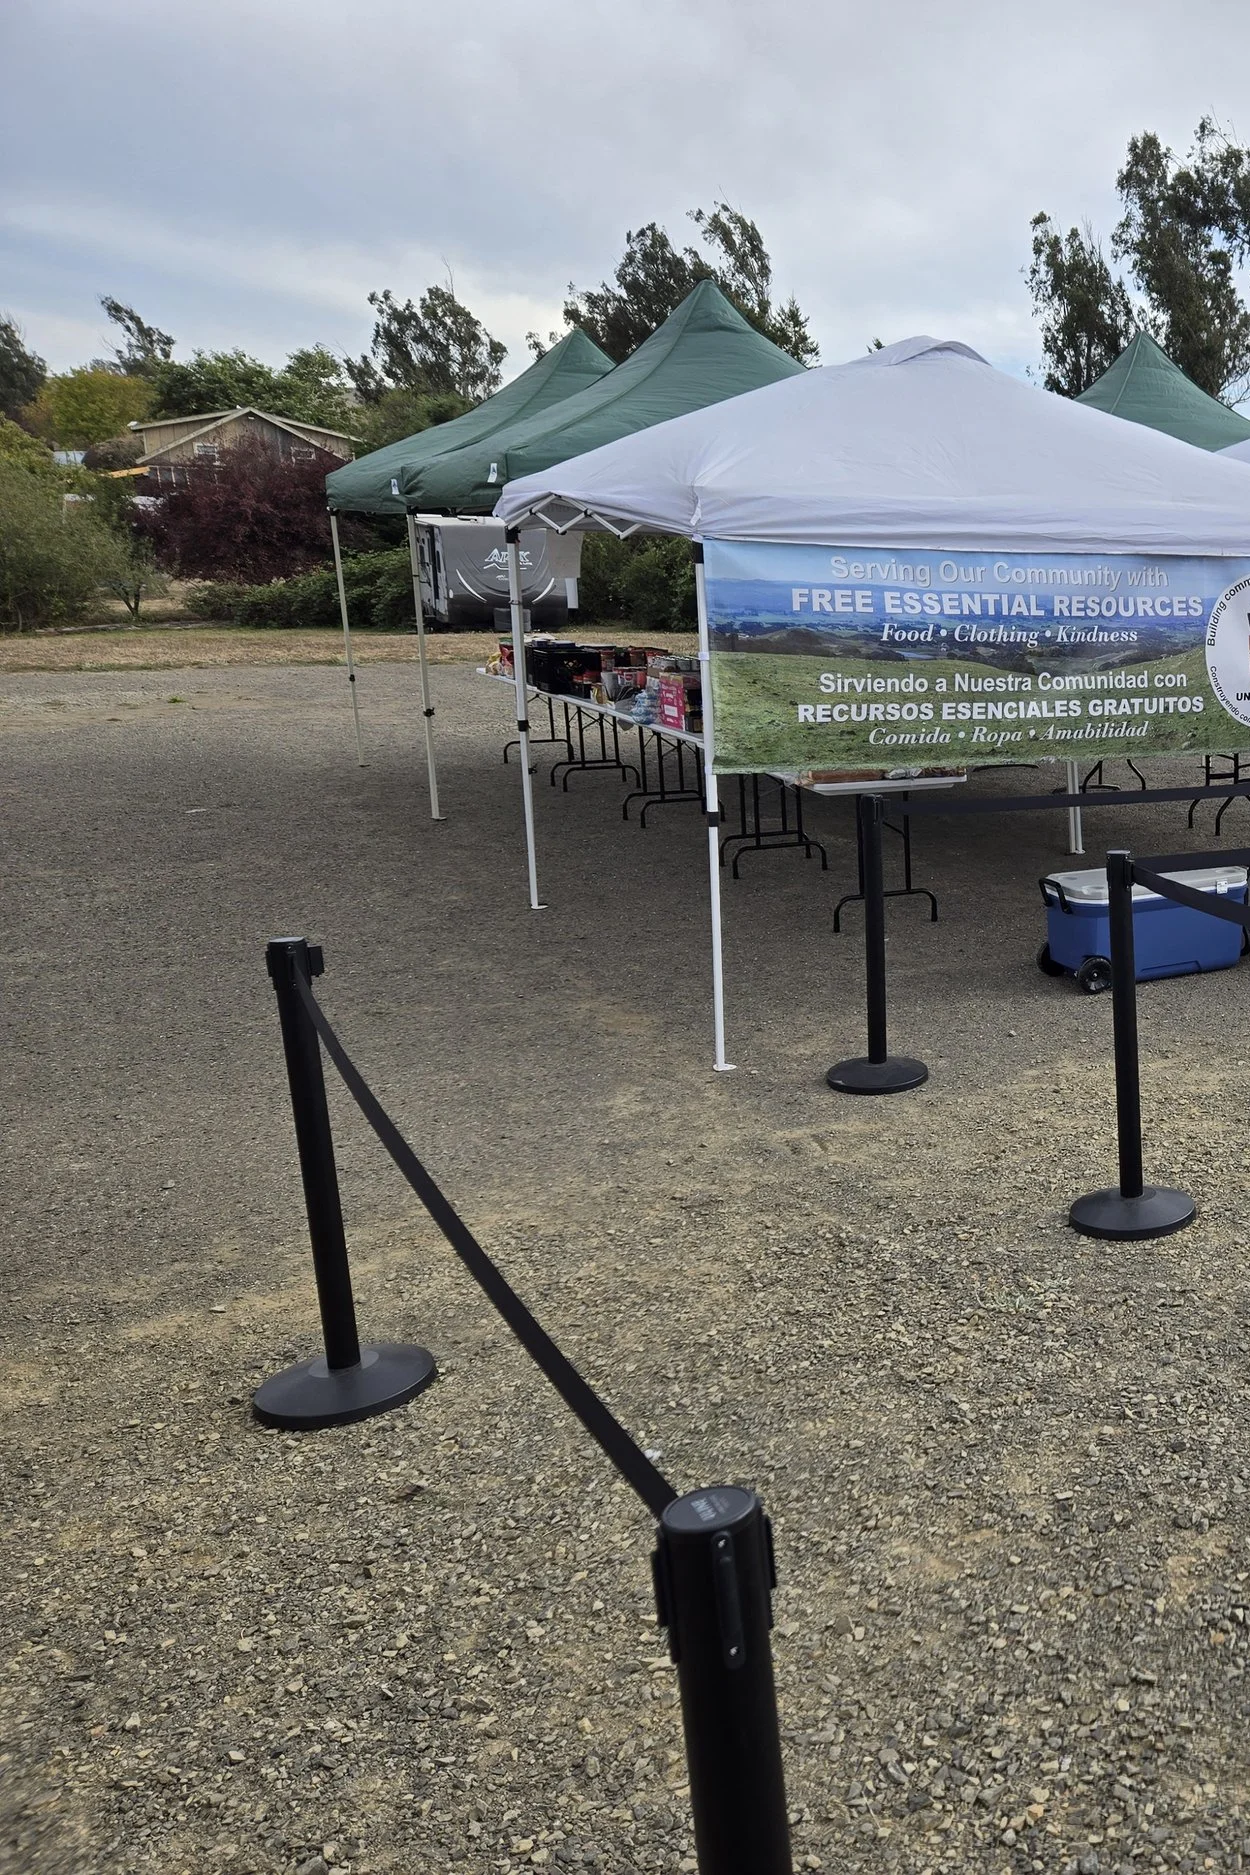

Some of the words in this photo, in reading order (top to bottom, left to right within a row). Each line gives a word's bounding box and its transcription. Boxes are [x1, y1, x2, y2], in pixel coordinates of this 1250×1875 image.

[830, 555, 932, 588] Serving
[939, 560, 986, 583] Our
[993, 561, 1122, 592] Community
[1127, 566, 1170, 587] with
[791, 588, 874, 613] FREE
[884, 591, 1045, 617] ESSENTIAL
[1053, 595, 1204, 618] RESOURCES
[880, 622, 935, 642] Food
[954, 624, 1040, 648] Clothing
[1056, 625, 1138, 643] Kindness
[1207, 601, 1227, 646] Building
[819, 673, 929, 693] Sirviendo
[935, 677, 947, 693] a
[954, 673, 1032, 693] Nuestra
[1038, 670, 1149, 690] Comunidad
[1154, 673, 1187, 688] con
[1210, 665, 1239, 716] Construyendo
[797, 702, 934, 723] RECURSOS
[942, 699, 1081, 721] ESENCIALES
[1088, 696, 1204, 717] GRATUITOS
[868, 726, 952, 745] Comida
[971, 726, 1022, 748] Ropa
[1039, 720, 1149, 741] Amabilidad
